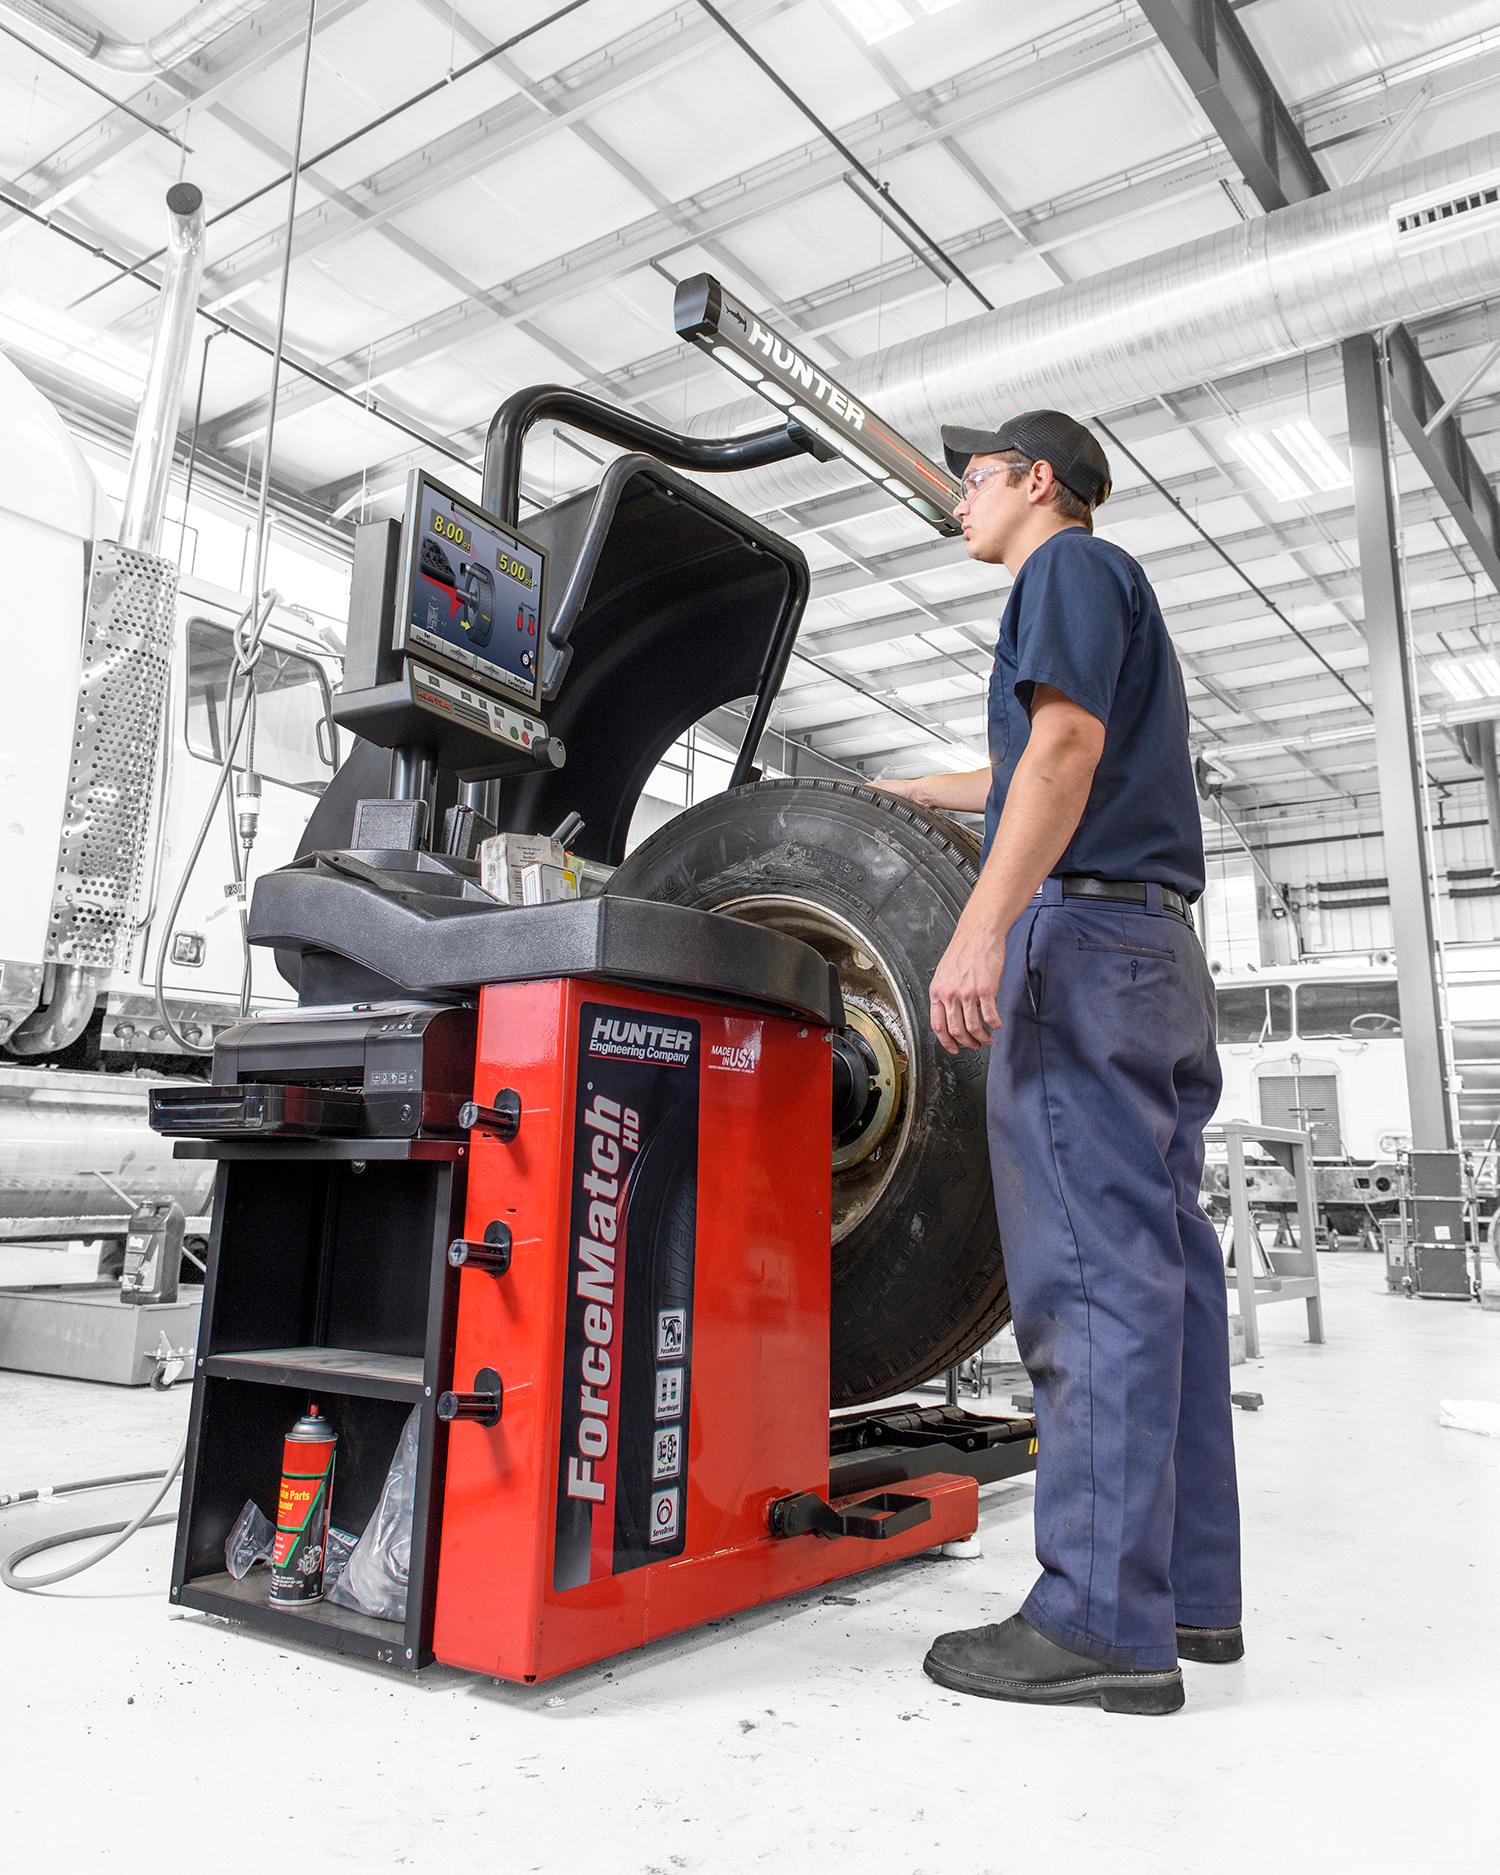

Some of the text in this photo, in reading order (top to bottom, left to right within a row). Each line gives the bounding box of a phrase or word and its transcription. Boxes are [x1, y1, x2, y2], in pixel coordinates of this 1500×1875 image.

[748, 320, 867, 431] HUNTER
[434, 515, 464, 545] 8.00
[499, 554, 526, 581] 5.00
[417, 689, 452, 710] HUNTER
[592, 1017, 693, 1051] HUNTER
[589, 1039, 690, 1065] Engineering Company
[711, 1045, 731, 1057] MADE
[722, 1057, 730, 1066] IN
[729, 1048, 755, 1069] USA
[622, 1107, 640, 1153] HD
[289, 1490, 310, 1501] Parts
